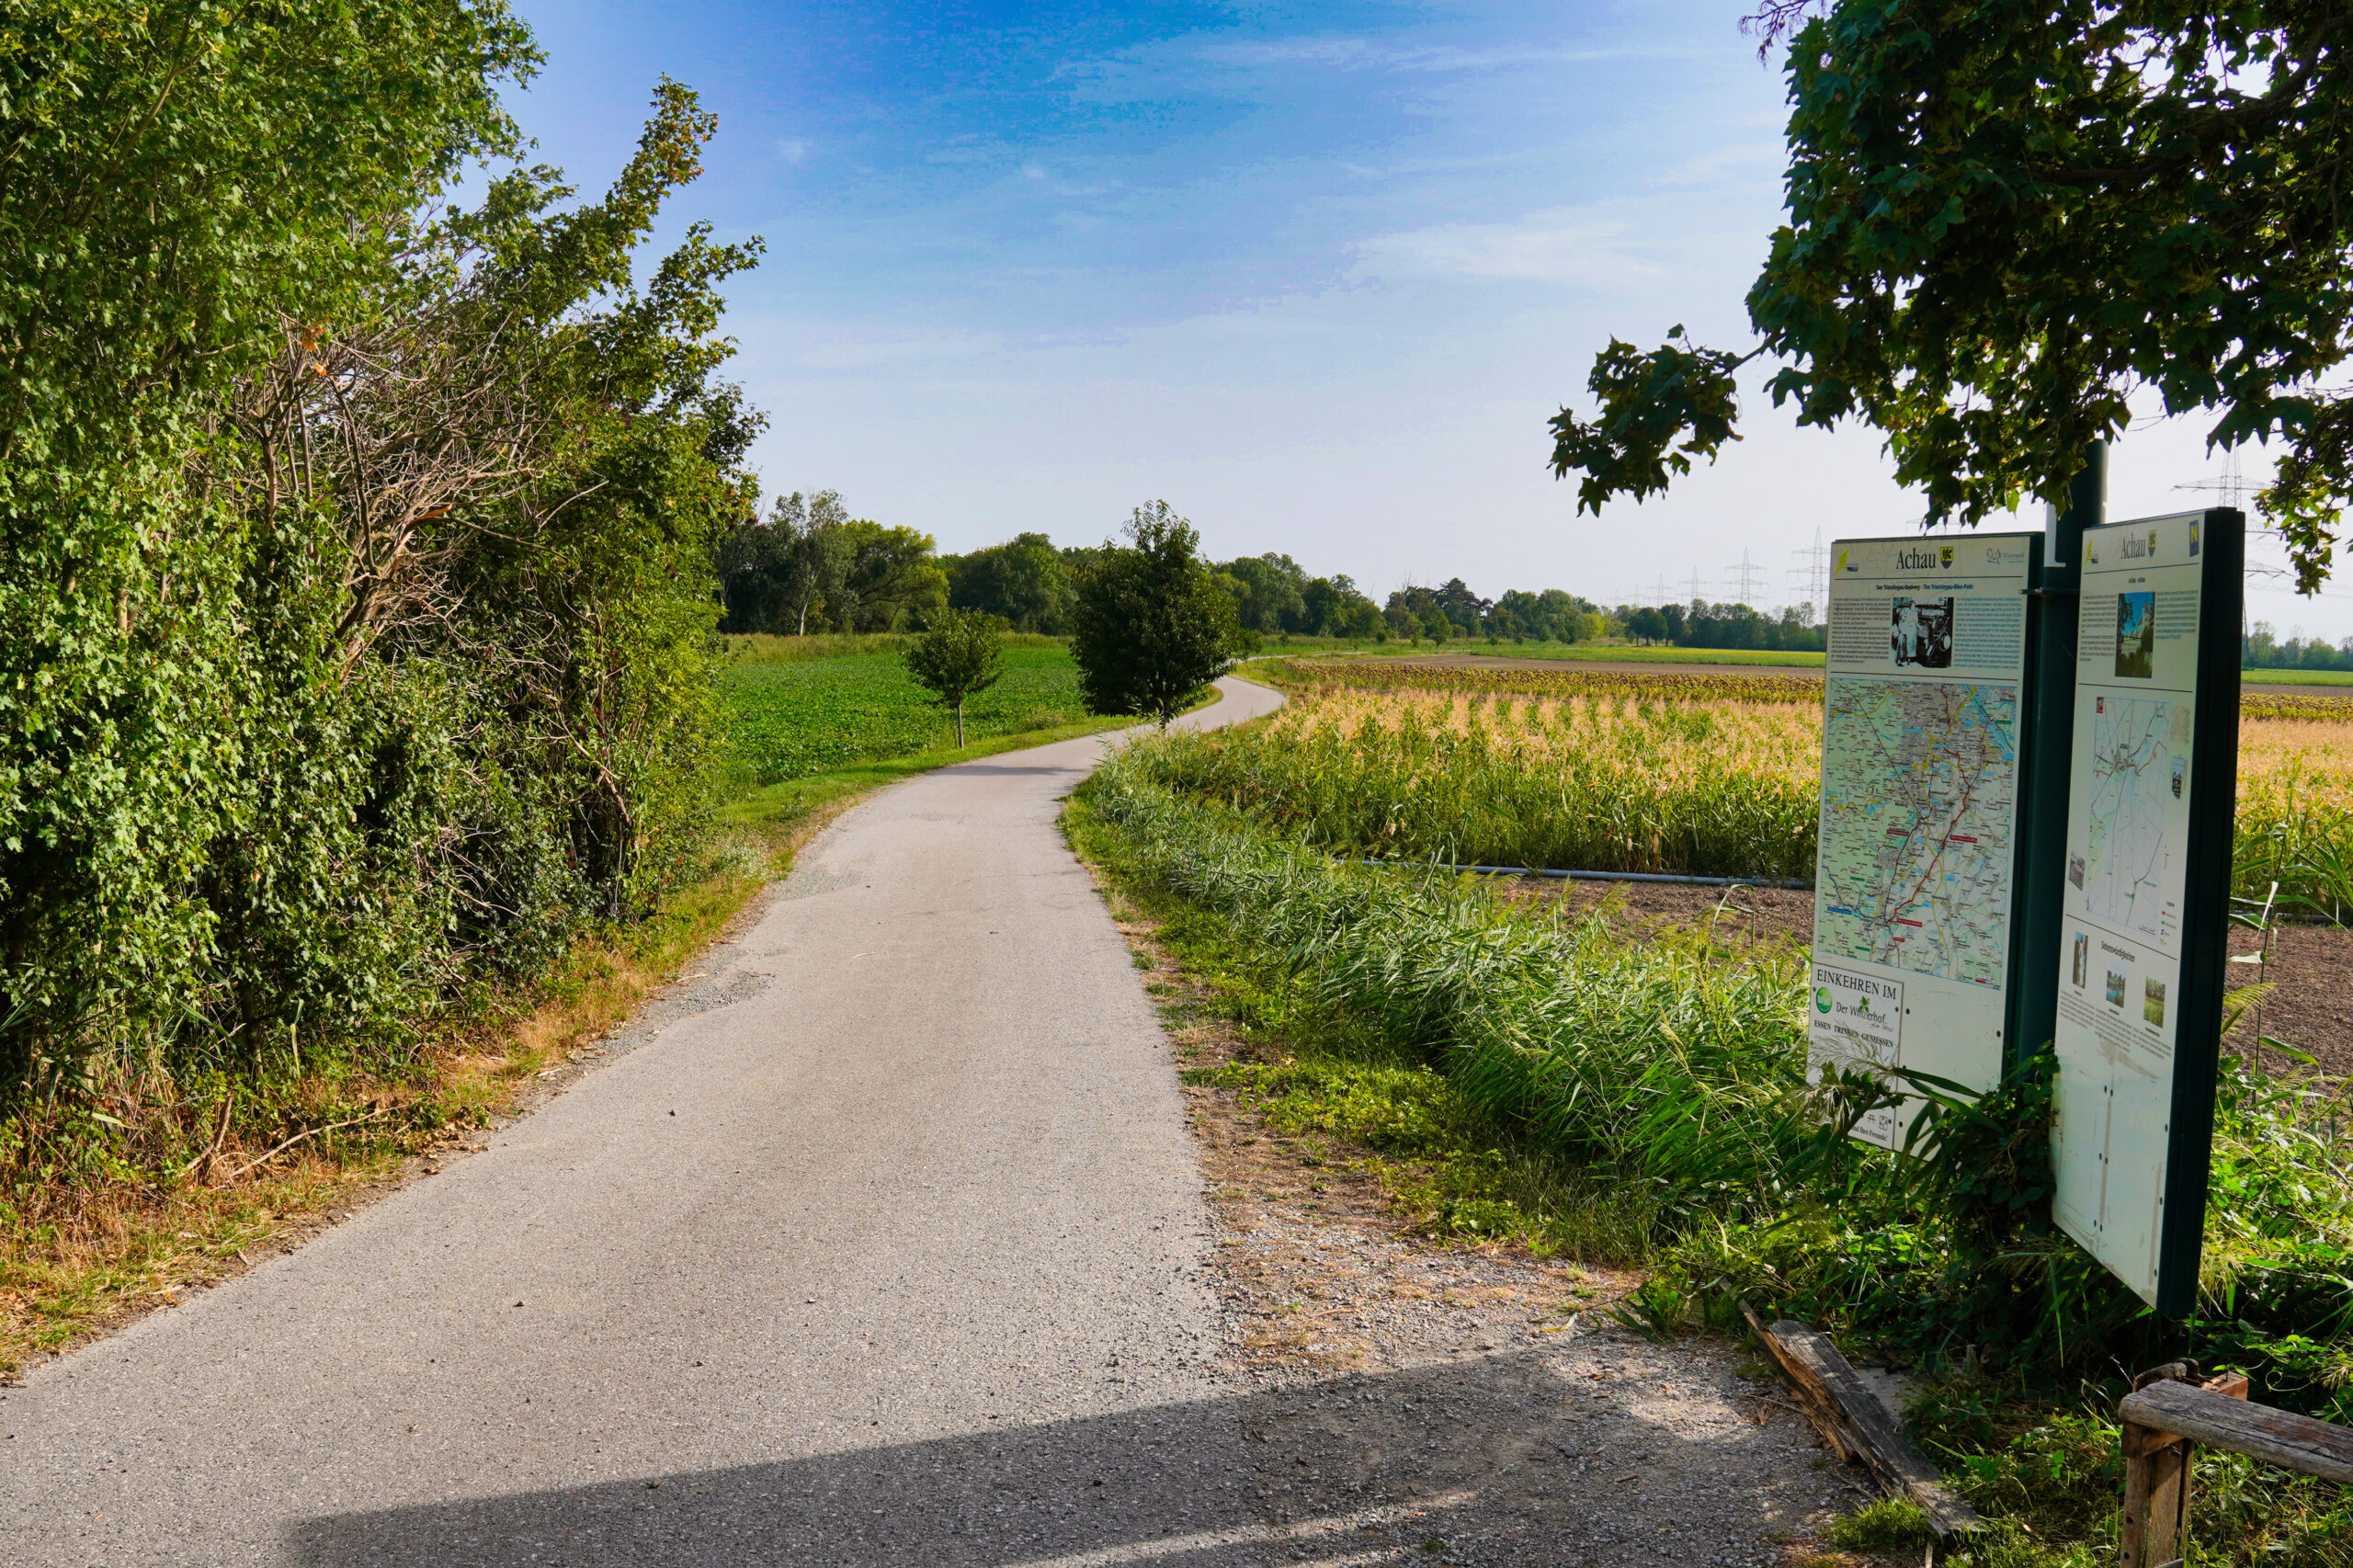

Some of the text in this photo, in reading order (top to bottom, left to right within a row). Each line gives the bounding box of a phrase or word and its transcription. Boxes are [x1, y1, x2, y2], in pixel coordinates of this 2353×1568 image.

[2120, 533, 2146, 560] Achau
[1895, 548, 1936, 570] Achau
[1816, 969, 1897, 1000] EINKEHREN IM
[1836, 1002, 1848, 1015] Der
[1813, 1019, 1832, 1030] ESSEN
